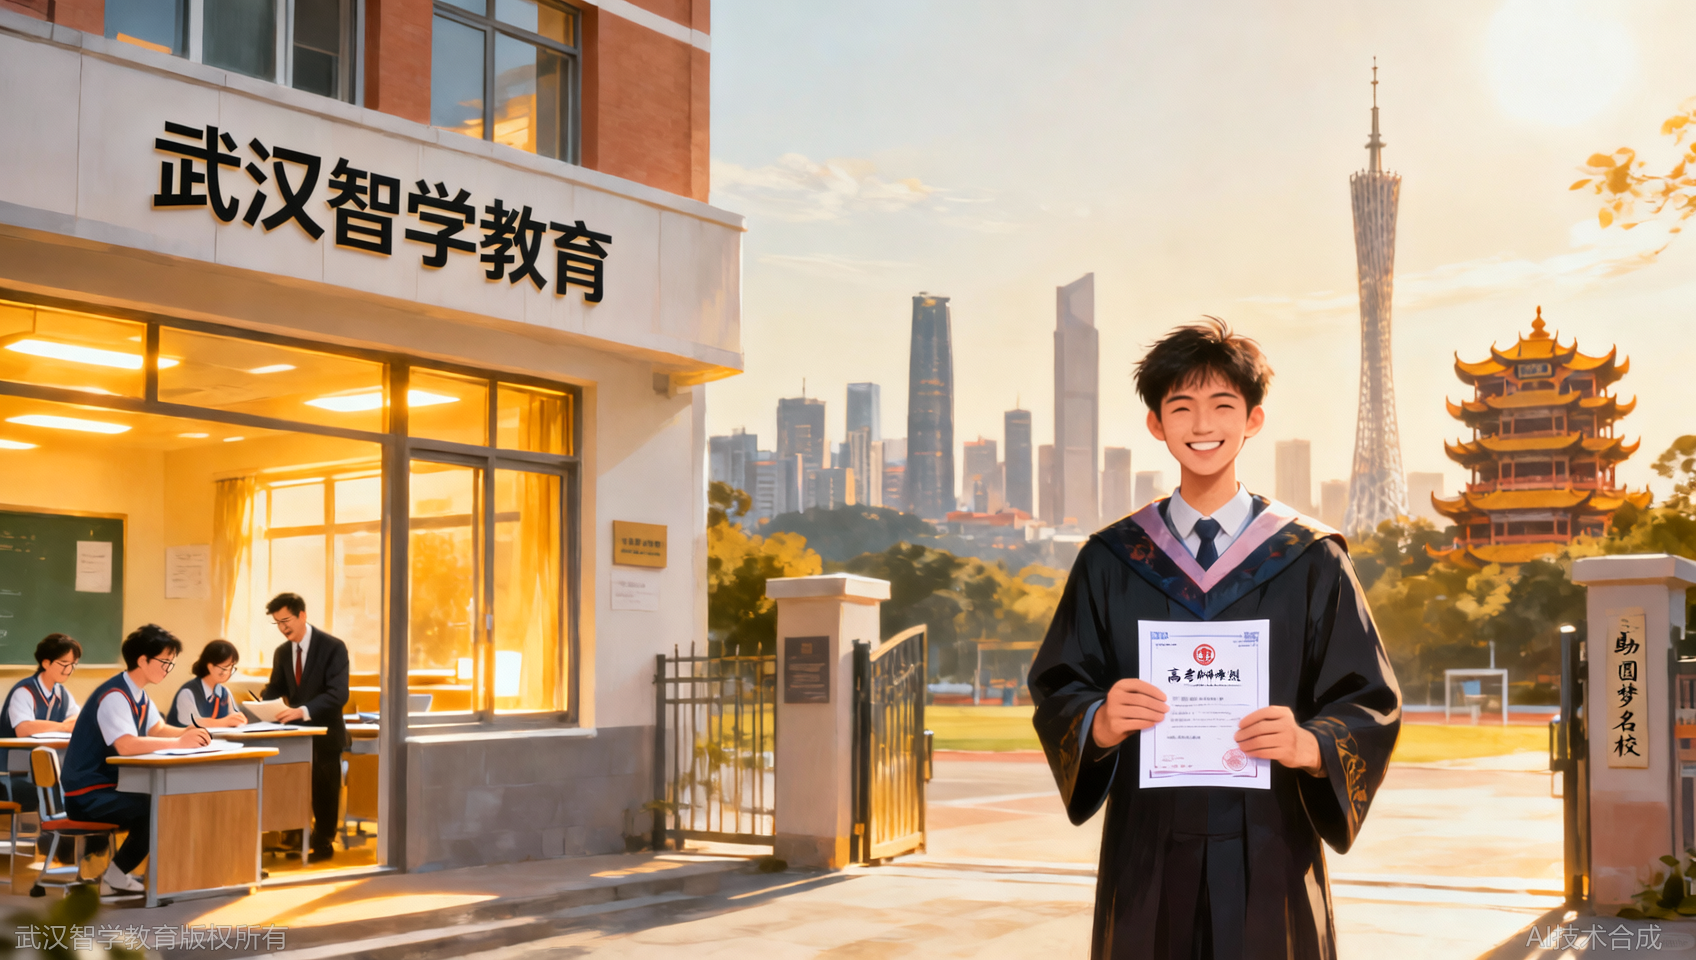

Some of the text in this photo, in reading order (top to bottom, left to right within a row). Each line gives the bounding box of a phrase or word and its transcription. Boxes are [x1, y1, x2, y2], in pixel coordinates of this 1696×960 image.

[153, 120, 612, 304] 武汉智学教育
